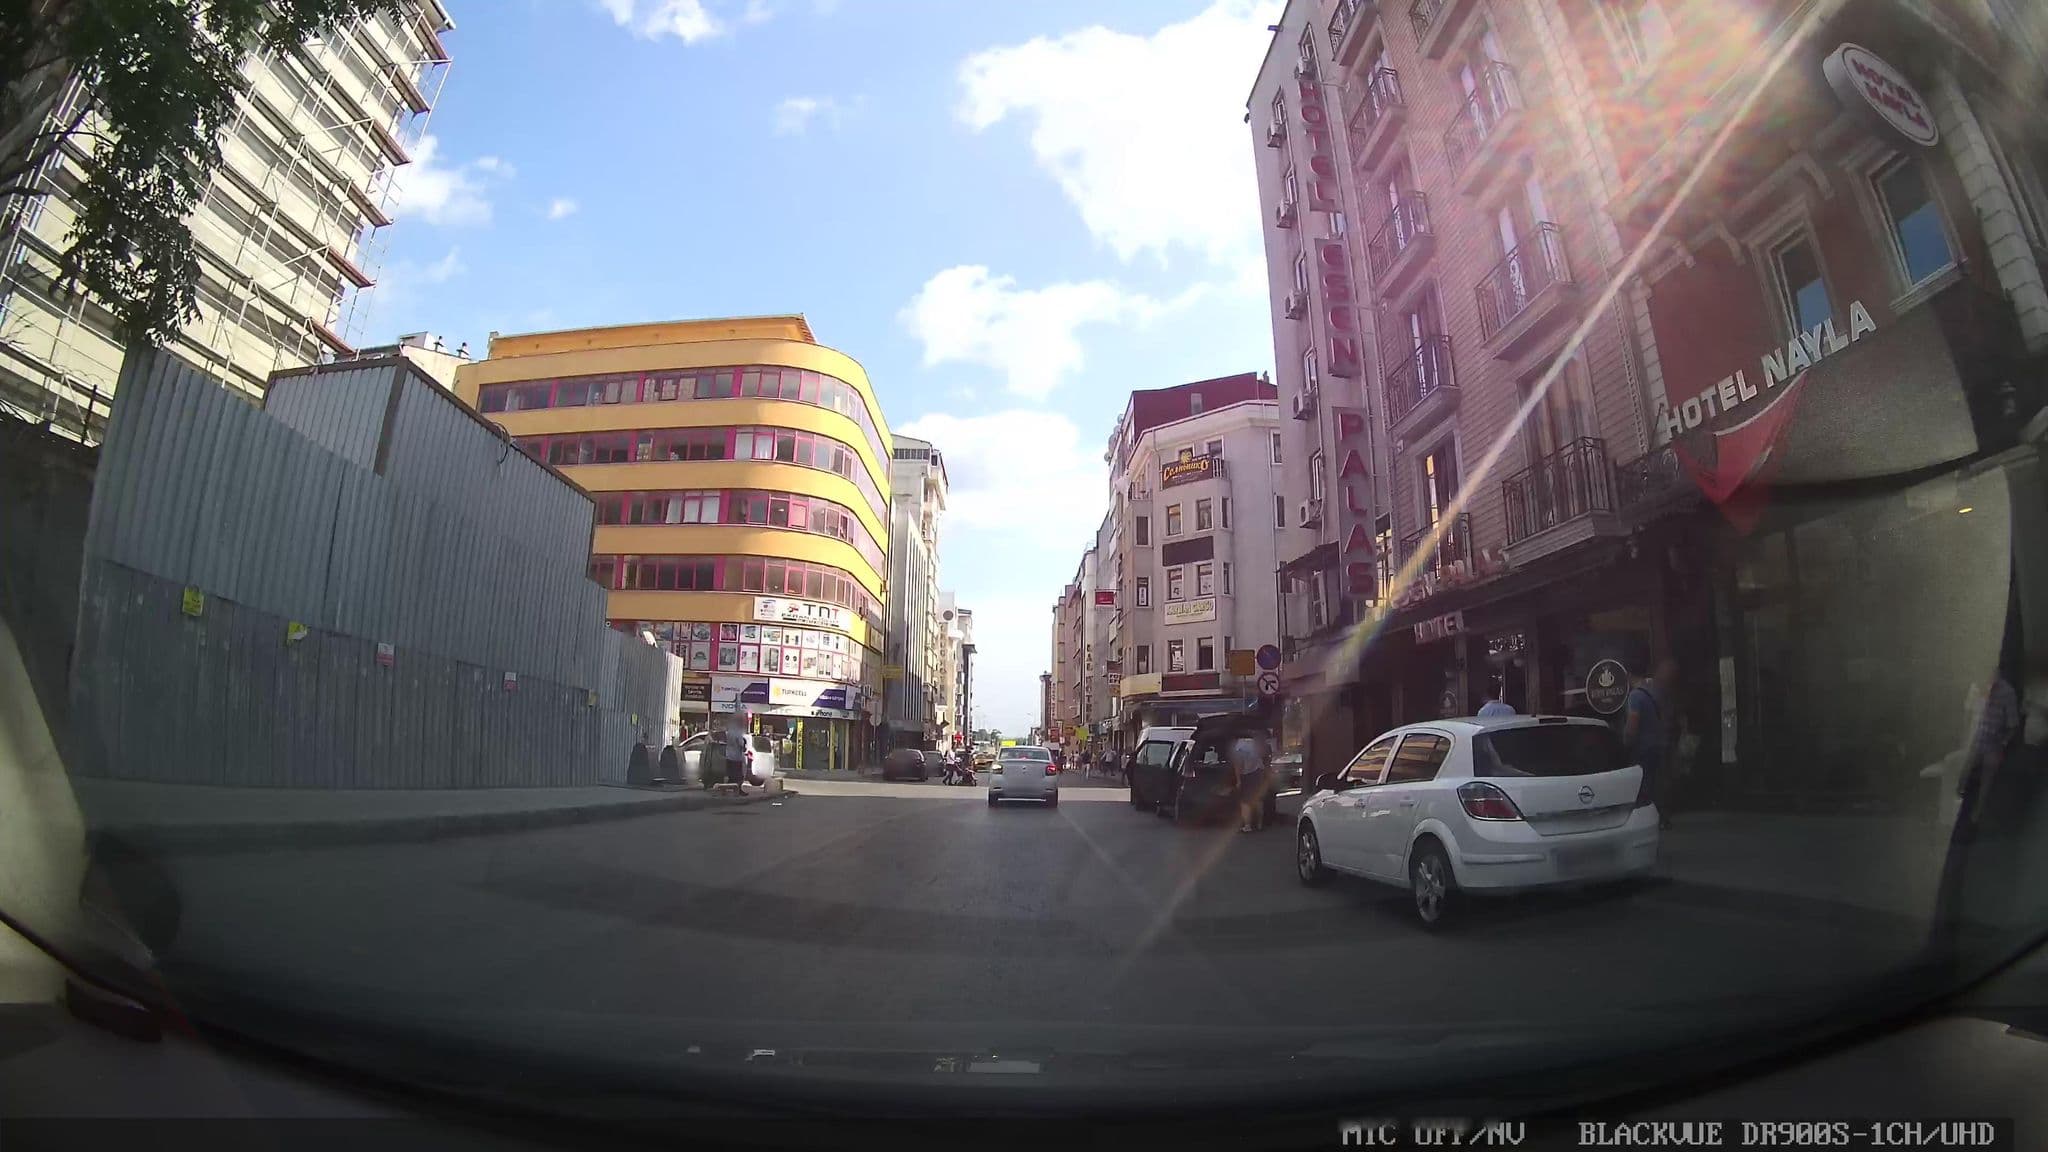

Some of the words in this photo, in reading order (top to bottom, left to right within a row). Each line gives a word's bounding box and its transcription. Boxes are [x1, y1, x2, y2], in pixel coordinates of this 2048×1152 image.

[1664, 369, 1758, 438] HOTEL
[1761, 299, 1877, 388] NAYLA
[1338, 412, 1374, 595] PALAS
